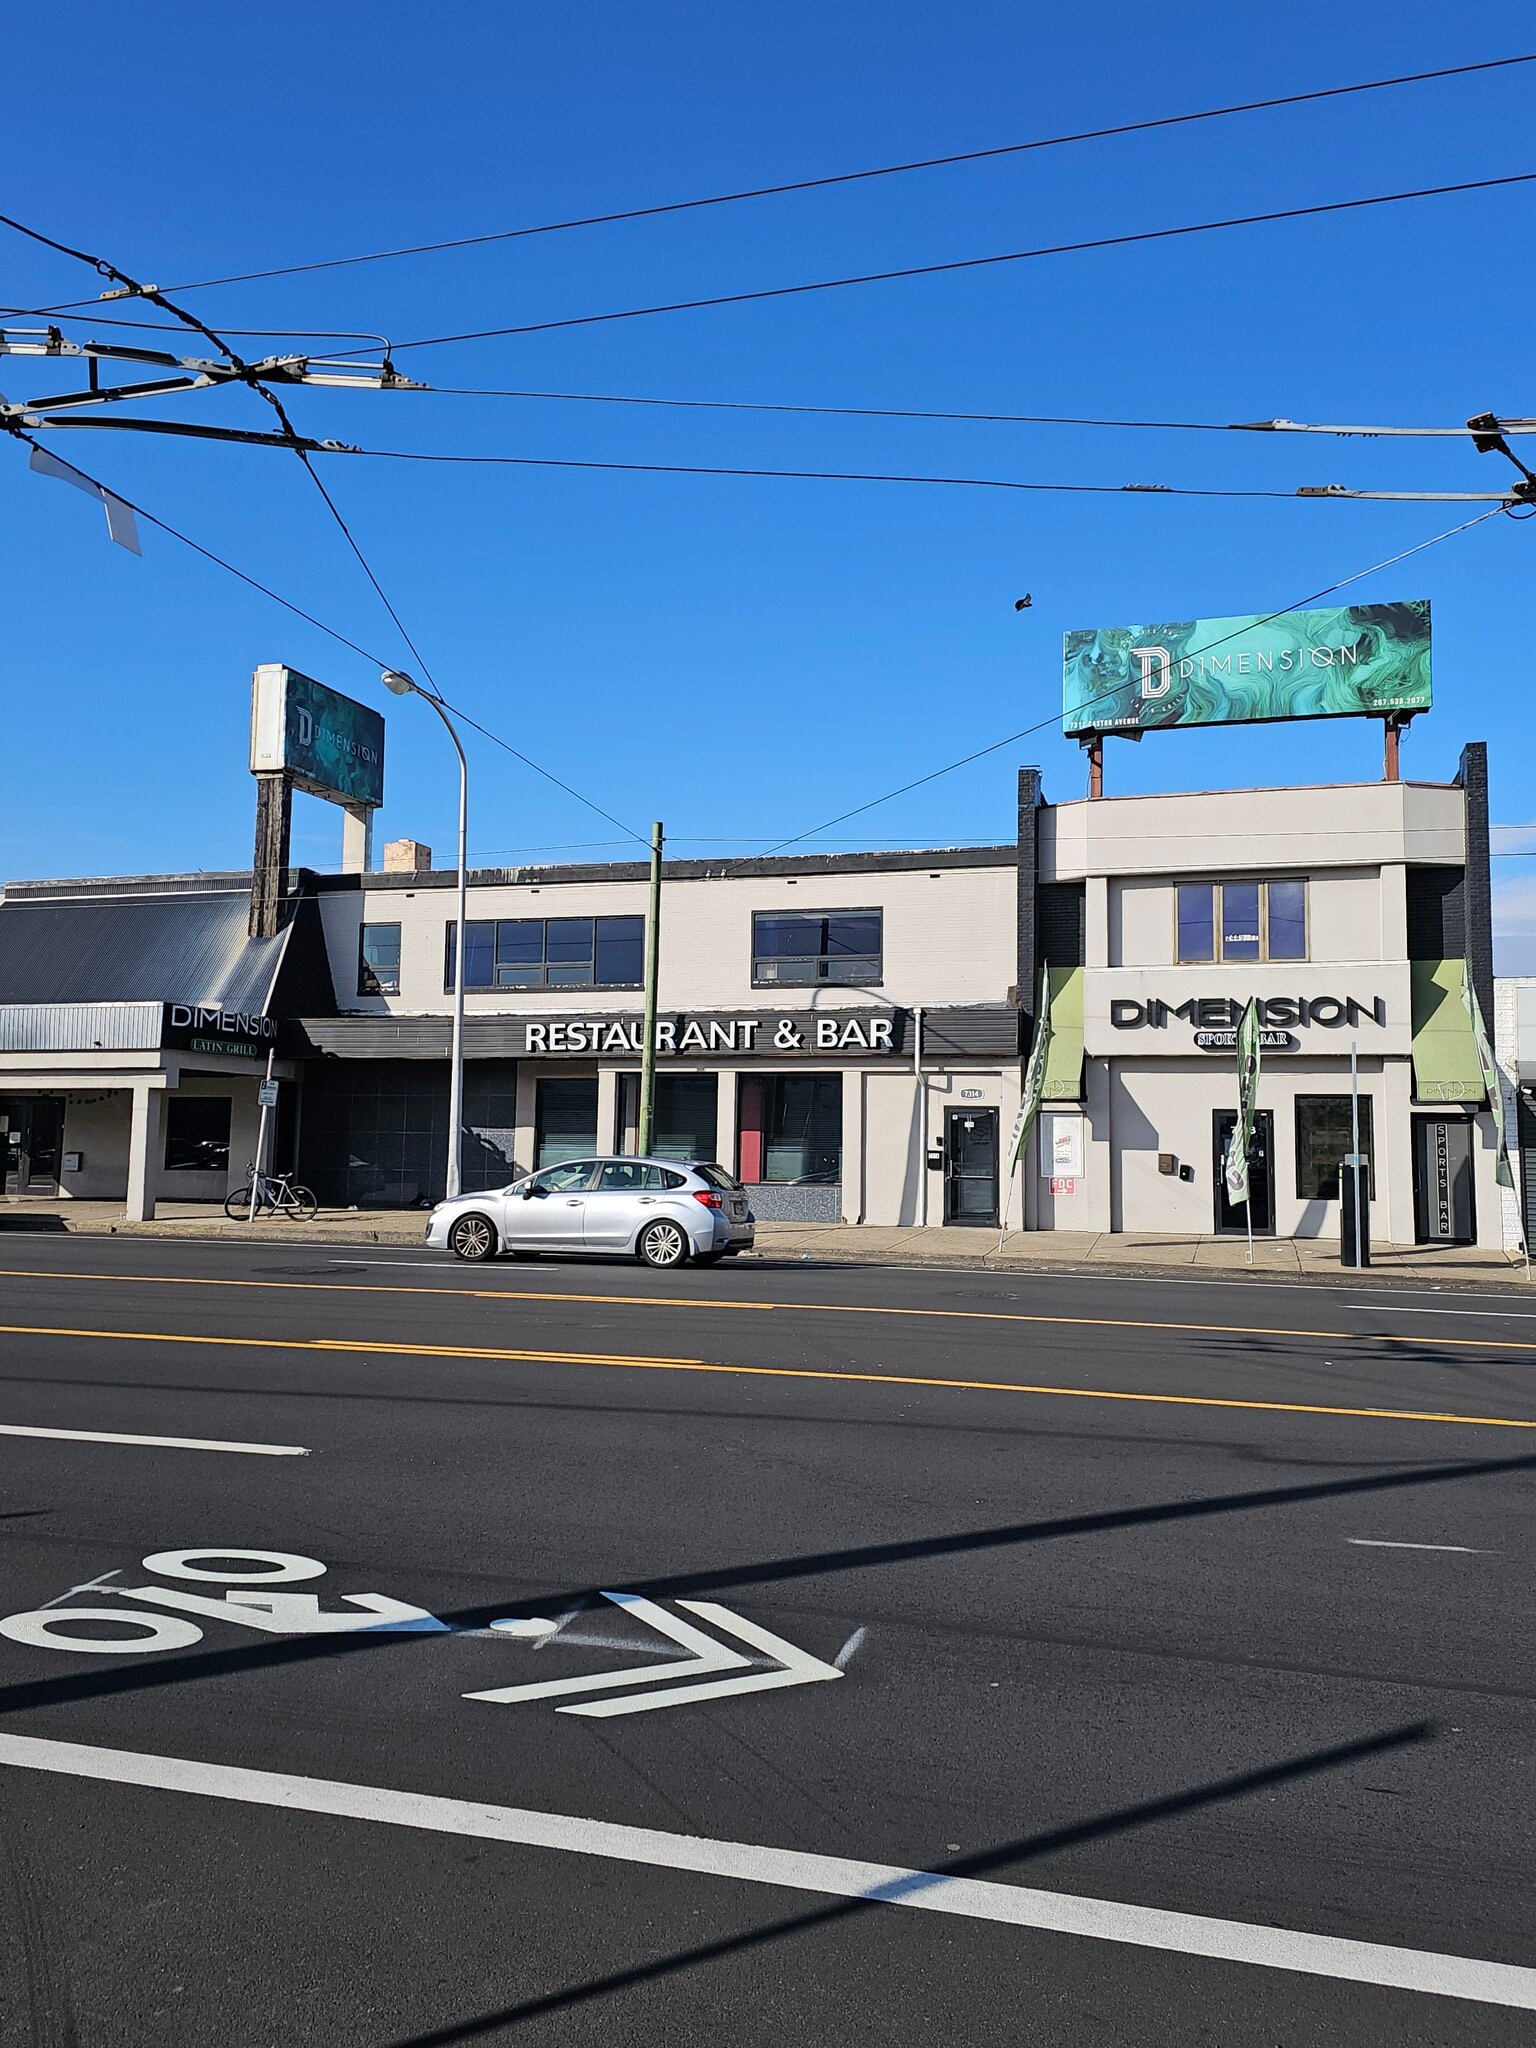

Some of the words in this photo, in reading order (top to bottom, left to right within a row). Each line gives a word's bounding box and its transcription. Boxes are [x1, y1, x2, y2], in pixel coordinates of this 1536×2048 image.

[1180, 644, 1358, 679] DIMENSION
[1114, 717, 1140, 726] AVENUE
[314, 724, 378, 765] DIMENSION
[171, 1005, 278, 1037] DIMENSION
[1111, 996, 1385, 1029] DIMENSION
[193, 1040, 223, 1052] LATIN
[226, 1043, 256, 1055] GRILL
[525, 1020, 759, 1051] RESTAURANT
[773, 1019, 801, 1049] &
[816, 1018, 895, 1048] BAR
[1197, 1033, 1239, 1045] SPOR
[1260, 1032, 1288, 1045] BAR
[964, 1090, 979, 1098] 7314
[1426, 1087, 1476, 1095] DIMENSION
[1437, 1125, 1448, 1188] SPORTS
[1051, 1179, 1073, 1188] FDC
[1439, 1200, 1449, 1231] BAR
